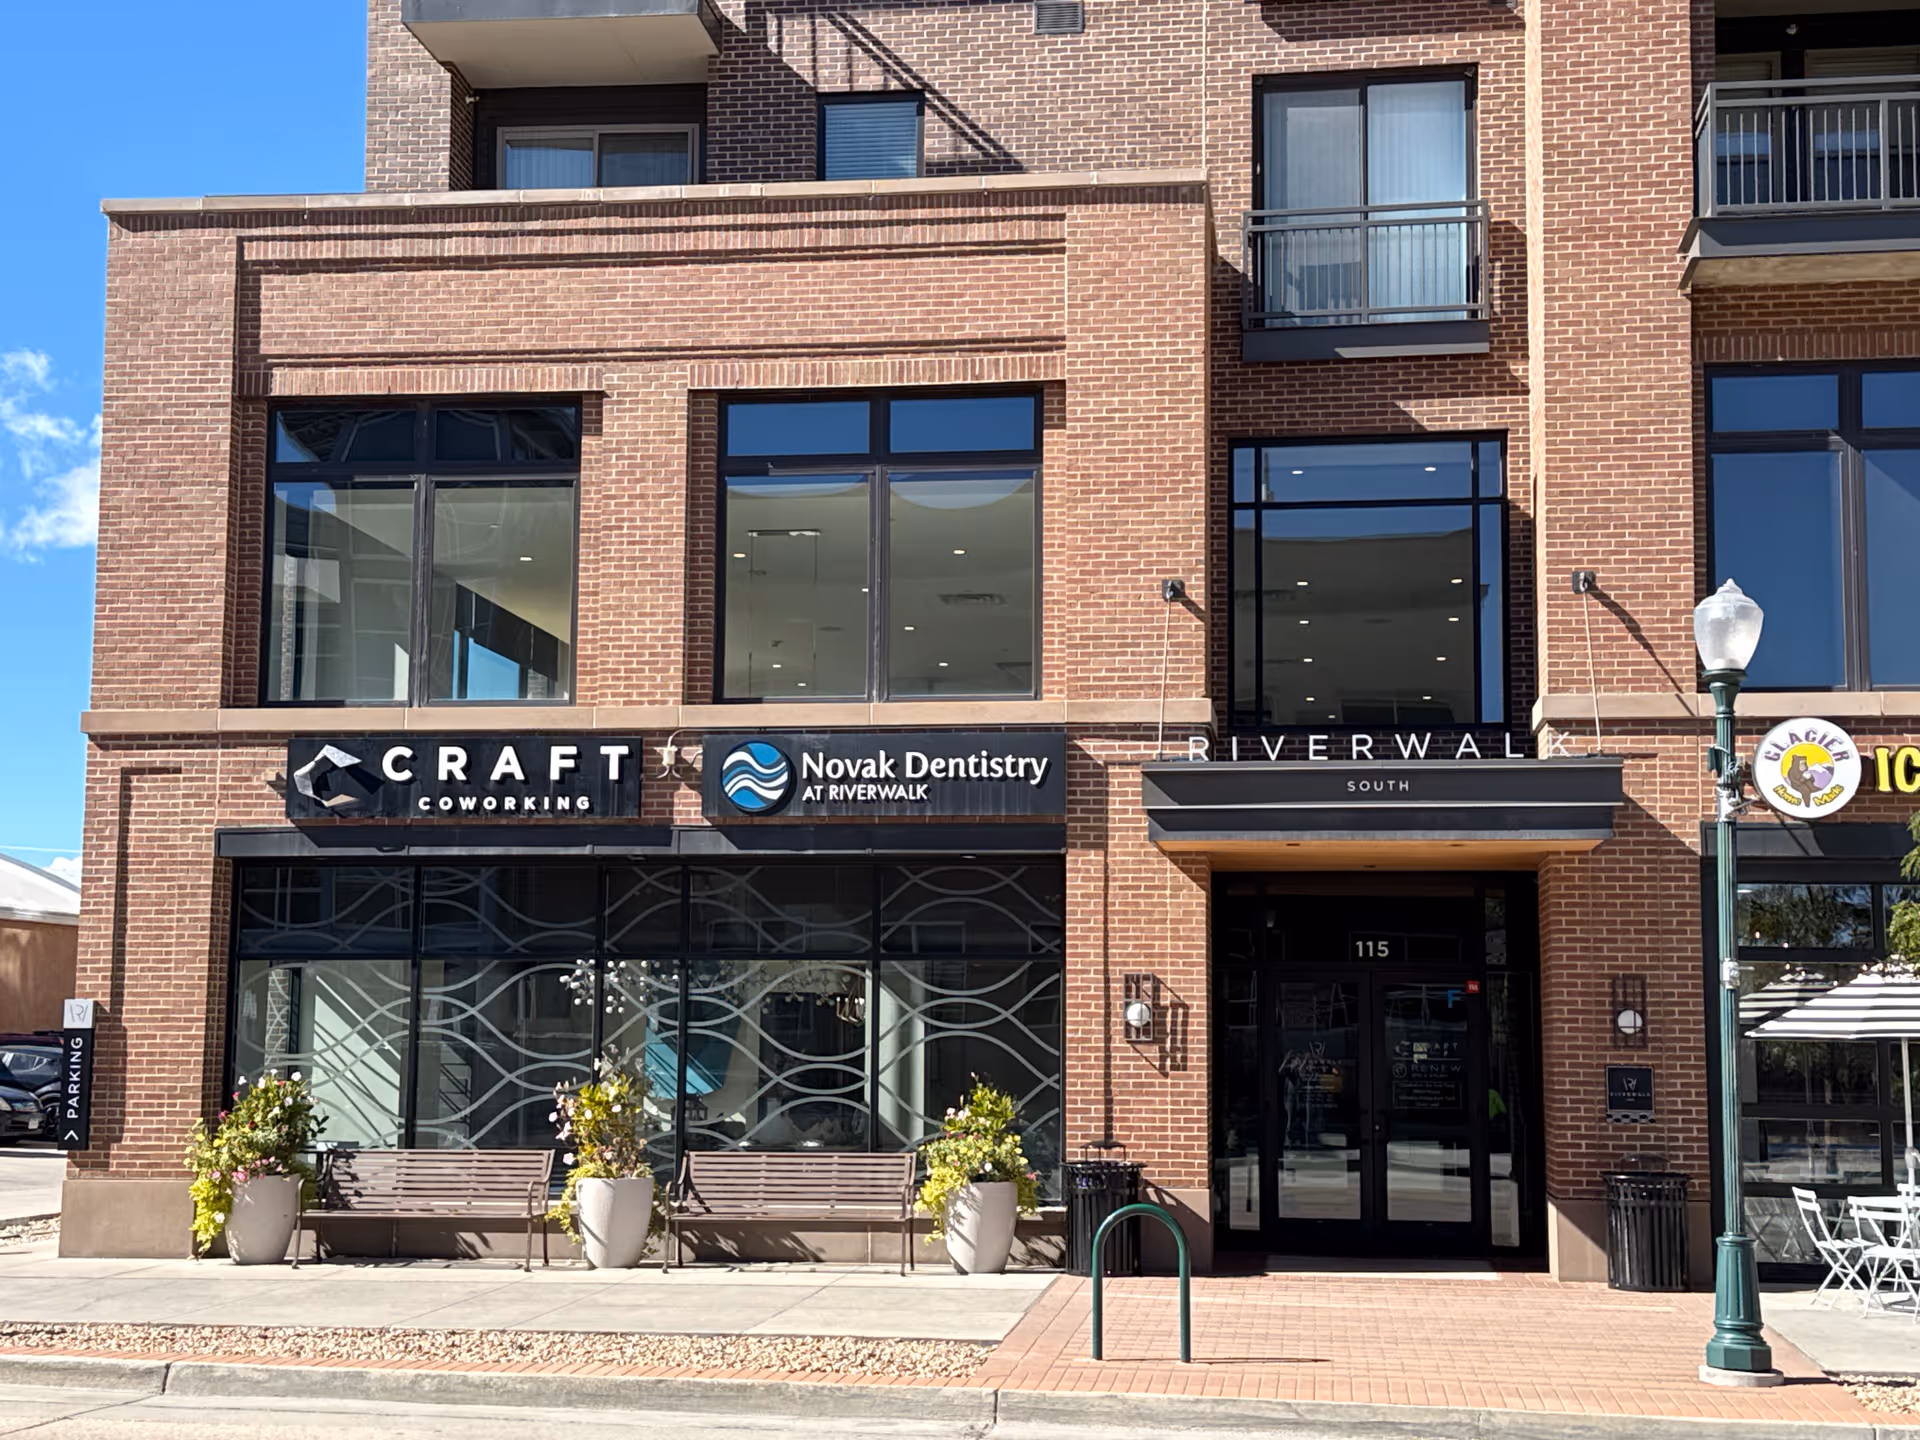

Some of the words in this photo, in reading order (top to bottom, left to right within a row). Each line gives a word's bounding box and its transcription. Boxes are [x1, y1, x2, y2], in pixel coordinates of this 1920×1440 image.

[1188, 732, 1572, 762] RIVERWALK
[1763, 728, 1852, 762] GLACIER
[381, 745, 630, 781] CRAFT
[801, 750, 896, 779] Novak
[905, 750, 1048, 785] Dentistry
[802, 785, 826, 800] AT
[829, 784, 928, 800] RIVERWALK
[1347, 780, 1410, 792] SOUTH
[418, 796, 590, 811] COWORKING
[1356, 941, 1389, 957] 115
[67, 1037, 83, 1119] PARKING
